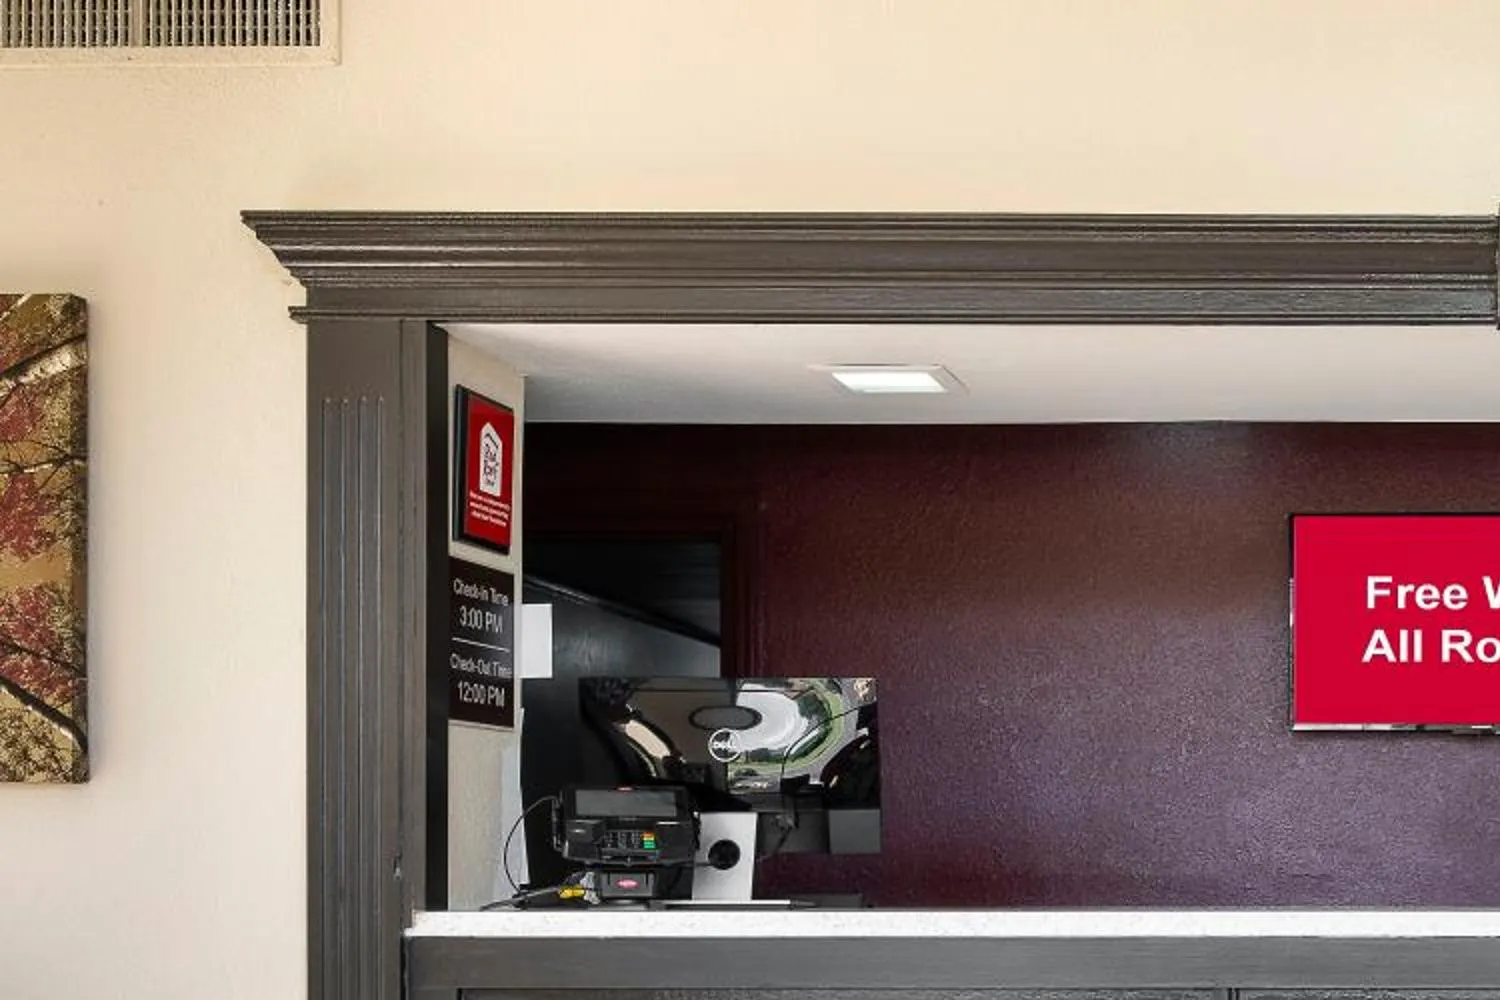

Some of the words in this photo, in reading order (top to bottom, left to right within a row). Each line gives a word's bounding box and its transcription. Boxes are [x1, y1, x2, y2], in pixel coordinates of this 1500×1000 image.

[490, 587, 508, 606] Time
[1366, 575, 1468, 609] Free
[459, 605, 483, 630] 3:00
[485, 611, 503, 633] PM
[1361, 629, 1423, 663] All
[450, 653, 490, 676] Check-Out
[492, 661, 512, 679] Time
[457, 680, 486, 704] 12:00
[487, 685, 505, 708] PM
